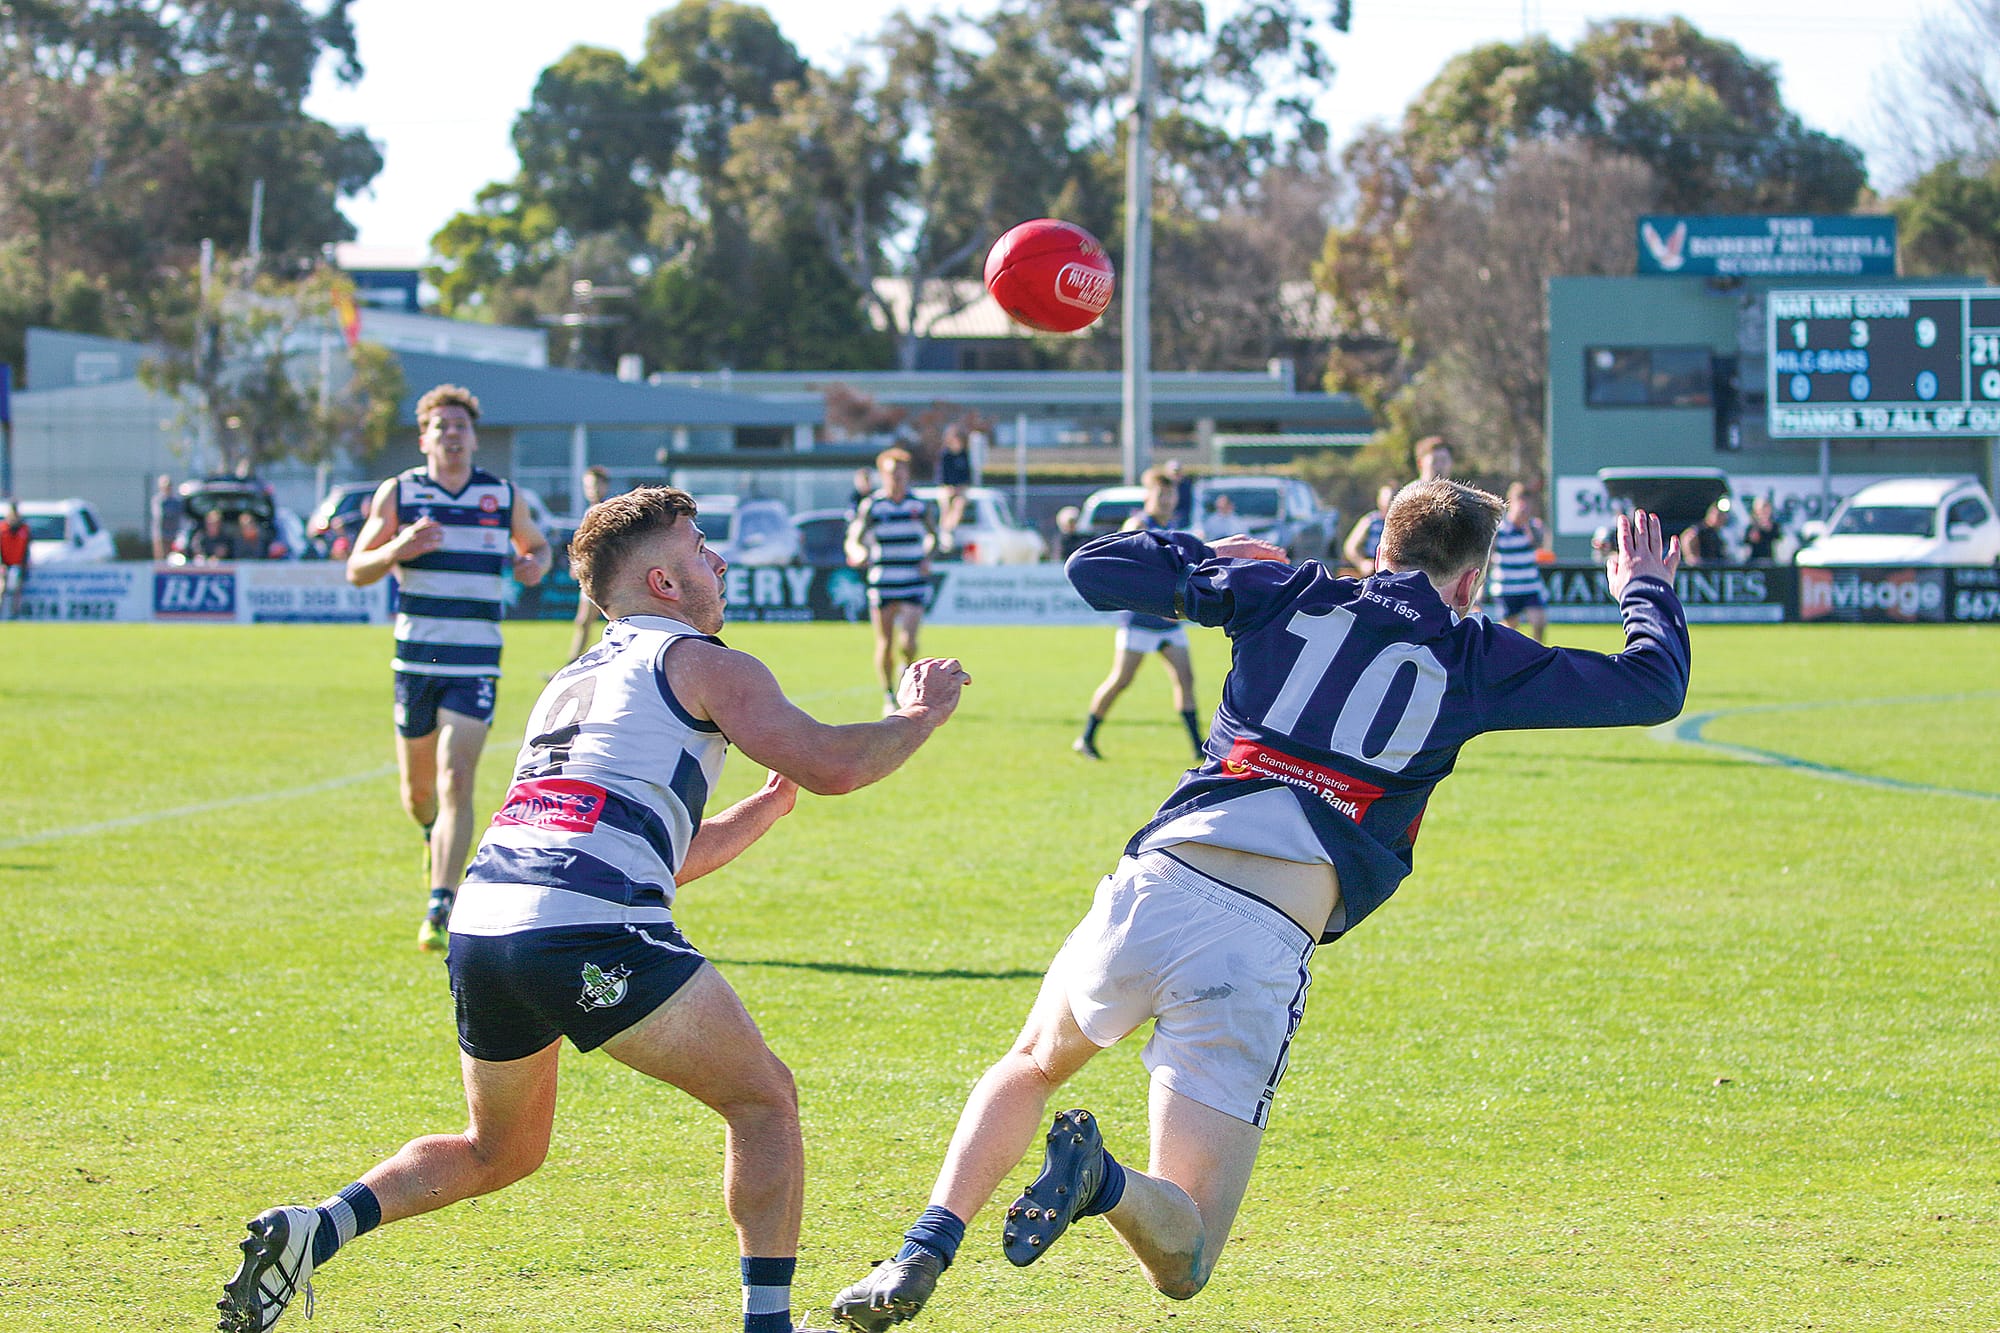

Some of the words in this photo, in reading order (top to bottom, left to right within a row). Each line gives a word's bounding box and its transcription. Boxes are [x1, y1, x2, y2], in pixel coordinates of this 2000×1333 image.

[1790, 320, 1808, 349] 1
[1850, 318, 1870, 348] 3
[1915, 317, 1938, 348] 9
[1790, 373, 1811, 402] 0
[1849, 373, 1871, 402] 0
[1915, 370, 1939, 401] 0
[1859, 406, 1890, 433] TO
[1891, 406, 1933, 432] ALL
[1934, 406, 1967, 432] OF
[1363, 590, 1392, 609] EST.
[1393, 602, 1421, 622] 1957
[1261, 605, 1448, 774] 10
[1258, 752, 1305, 776] Grantville
[1305, 770, 1314, 779] &
[1315, 772, 1350, 791] District
[1319, 787, 1360, 820] Bank
